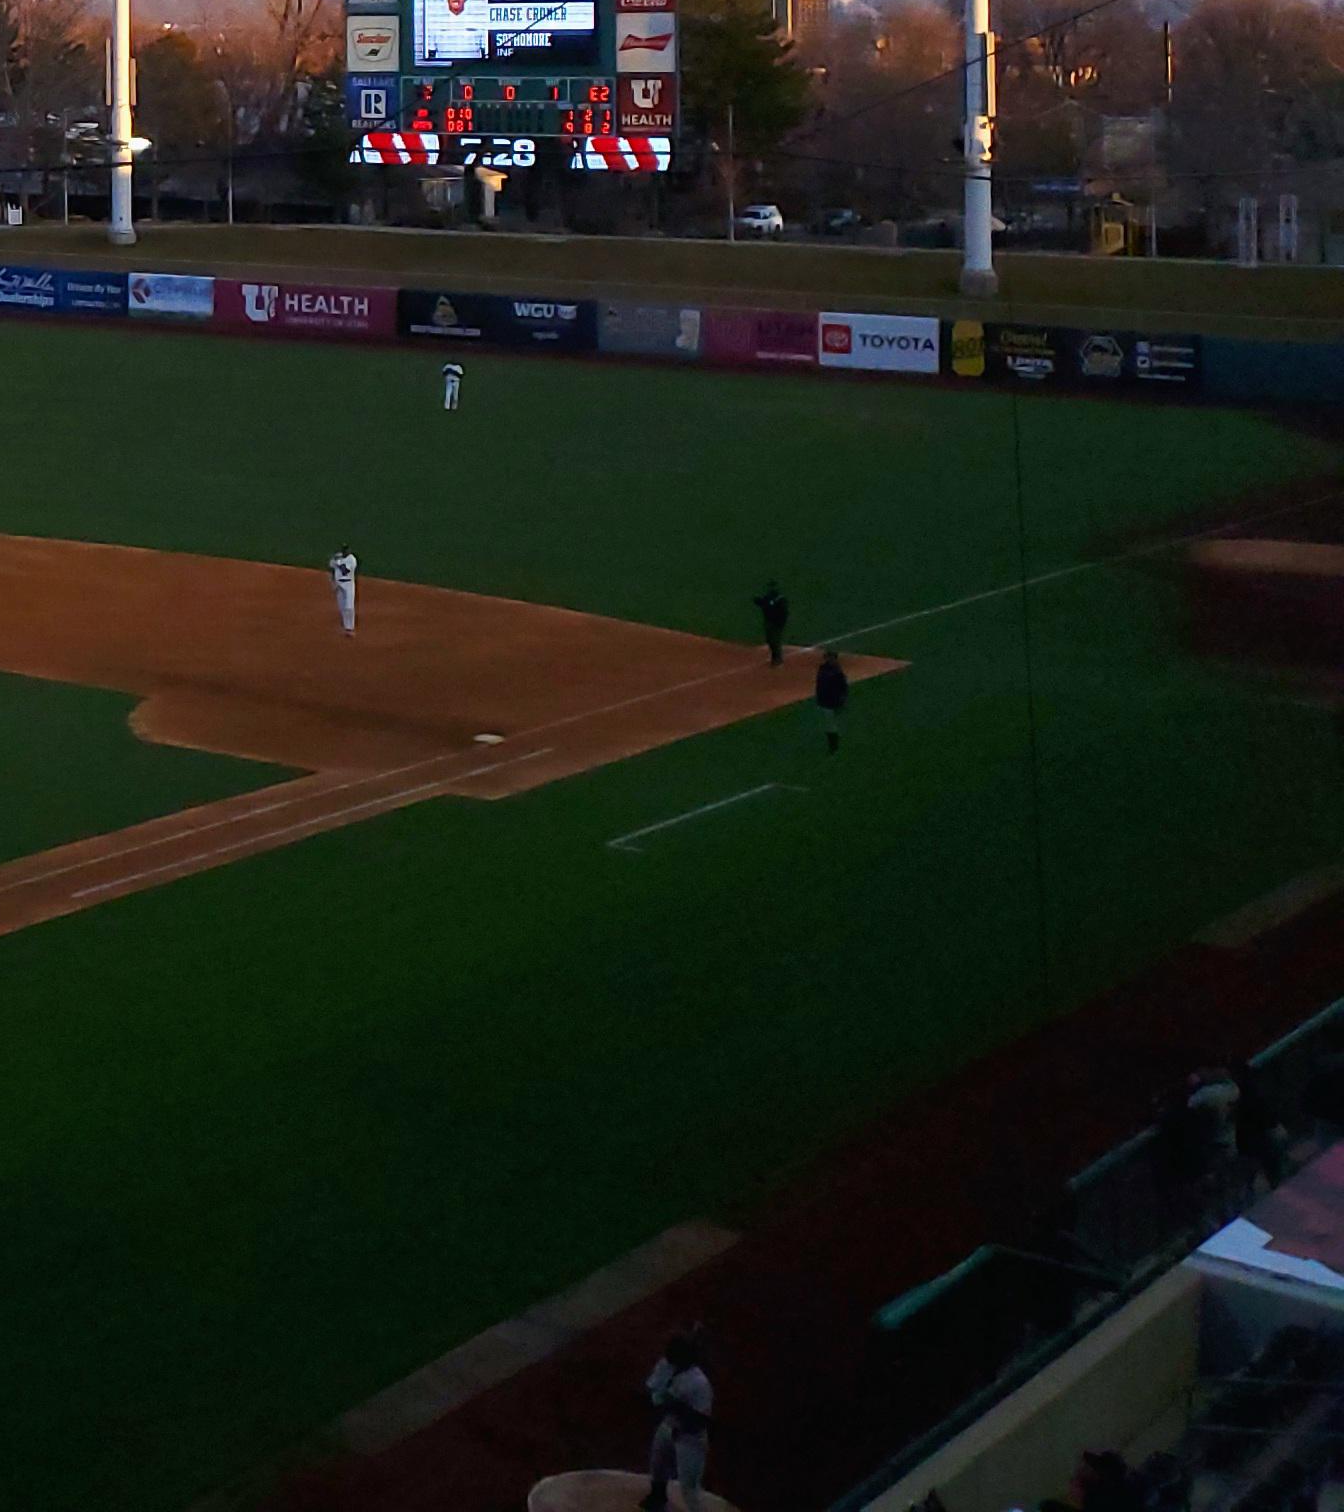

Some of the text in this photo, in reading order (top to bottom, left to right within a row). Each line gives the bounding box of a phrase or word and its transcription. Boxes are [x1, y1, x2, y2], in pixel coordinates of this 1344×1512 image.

[490, 7, 523, 22] CHASE
[622, 114, 672, 127] HEALTH
[284, 292, 369, 316] HEALTH
[514, 302, 555, 318] WGU
[858, 332, 935, 352] TOYOTA
